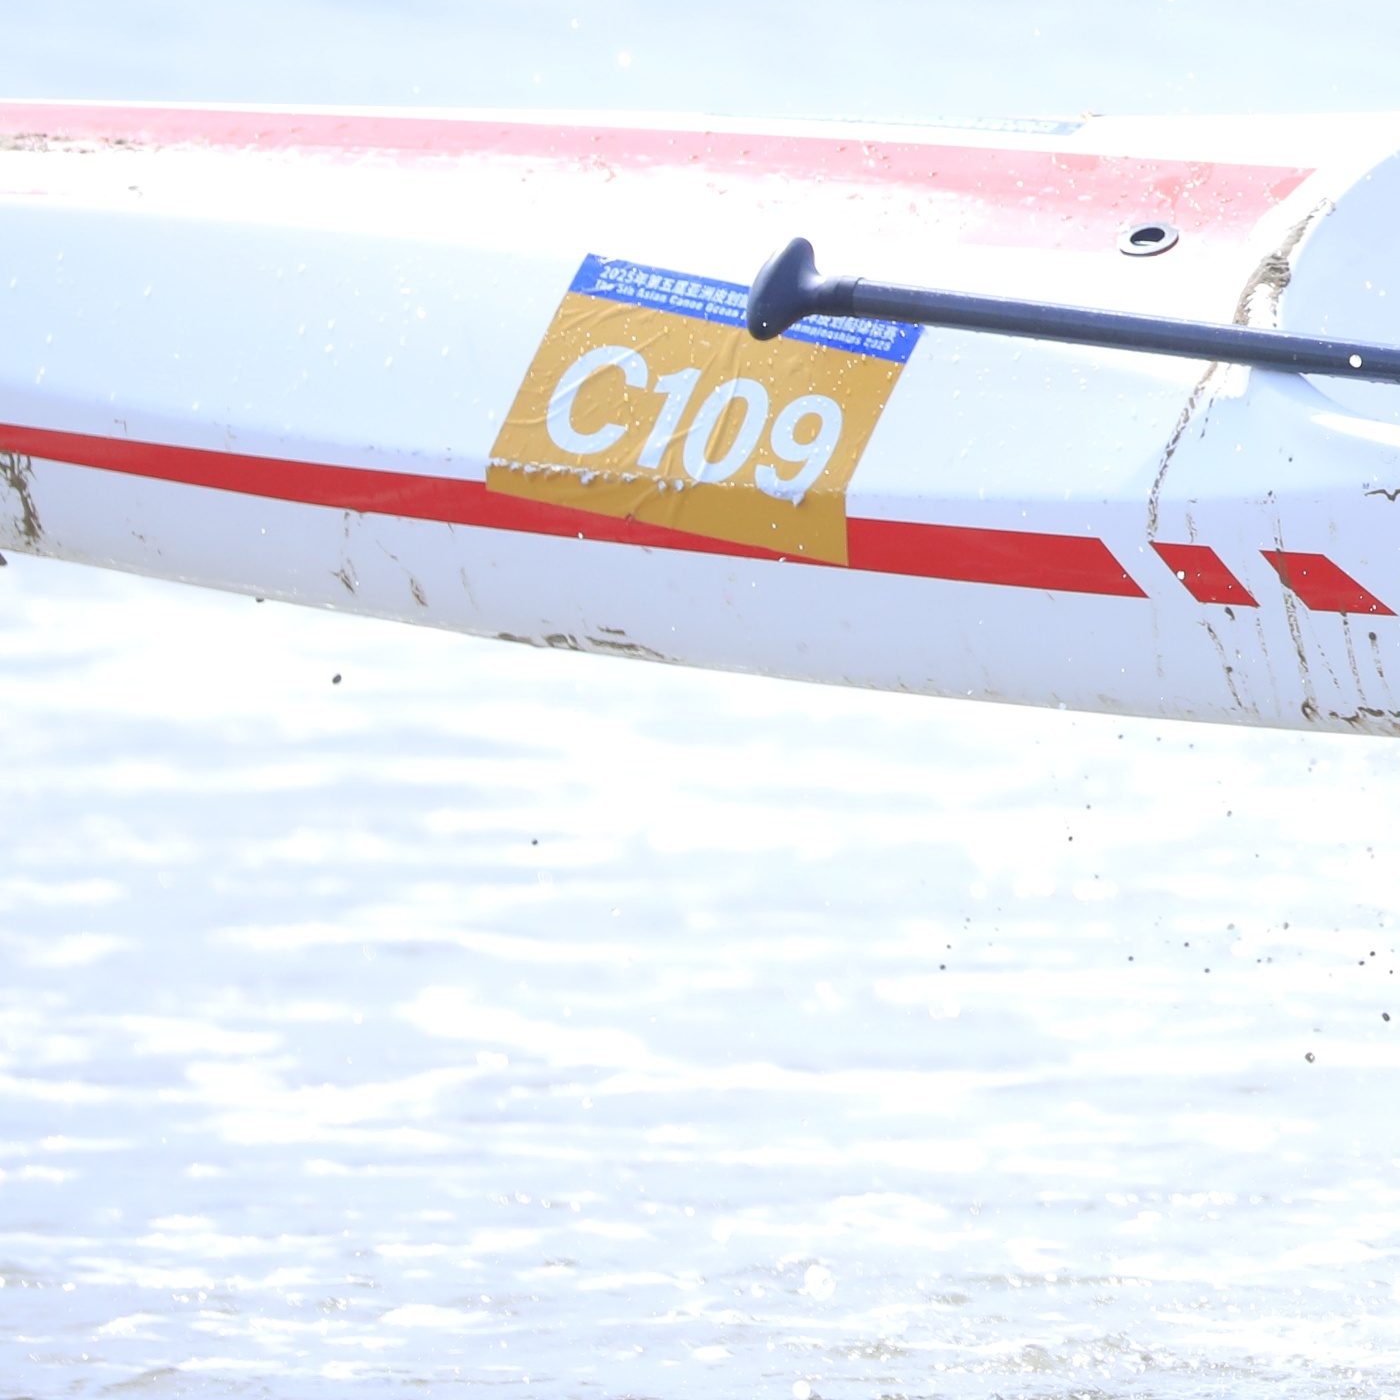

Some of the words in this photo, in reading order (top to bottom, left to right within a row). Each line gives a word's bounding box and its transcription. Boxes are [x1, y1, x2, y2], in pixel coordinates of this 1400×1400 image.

[636, 287, 667, 303] Asian
[669, 294, 704, 311] Canoe
[545, 344, 843, 501] C109
